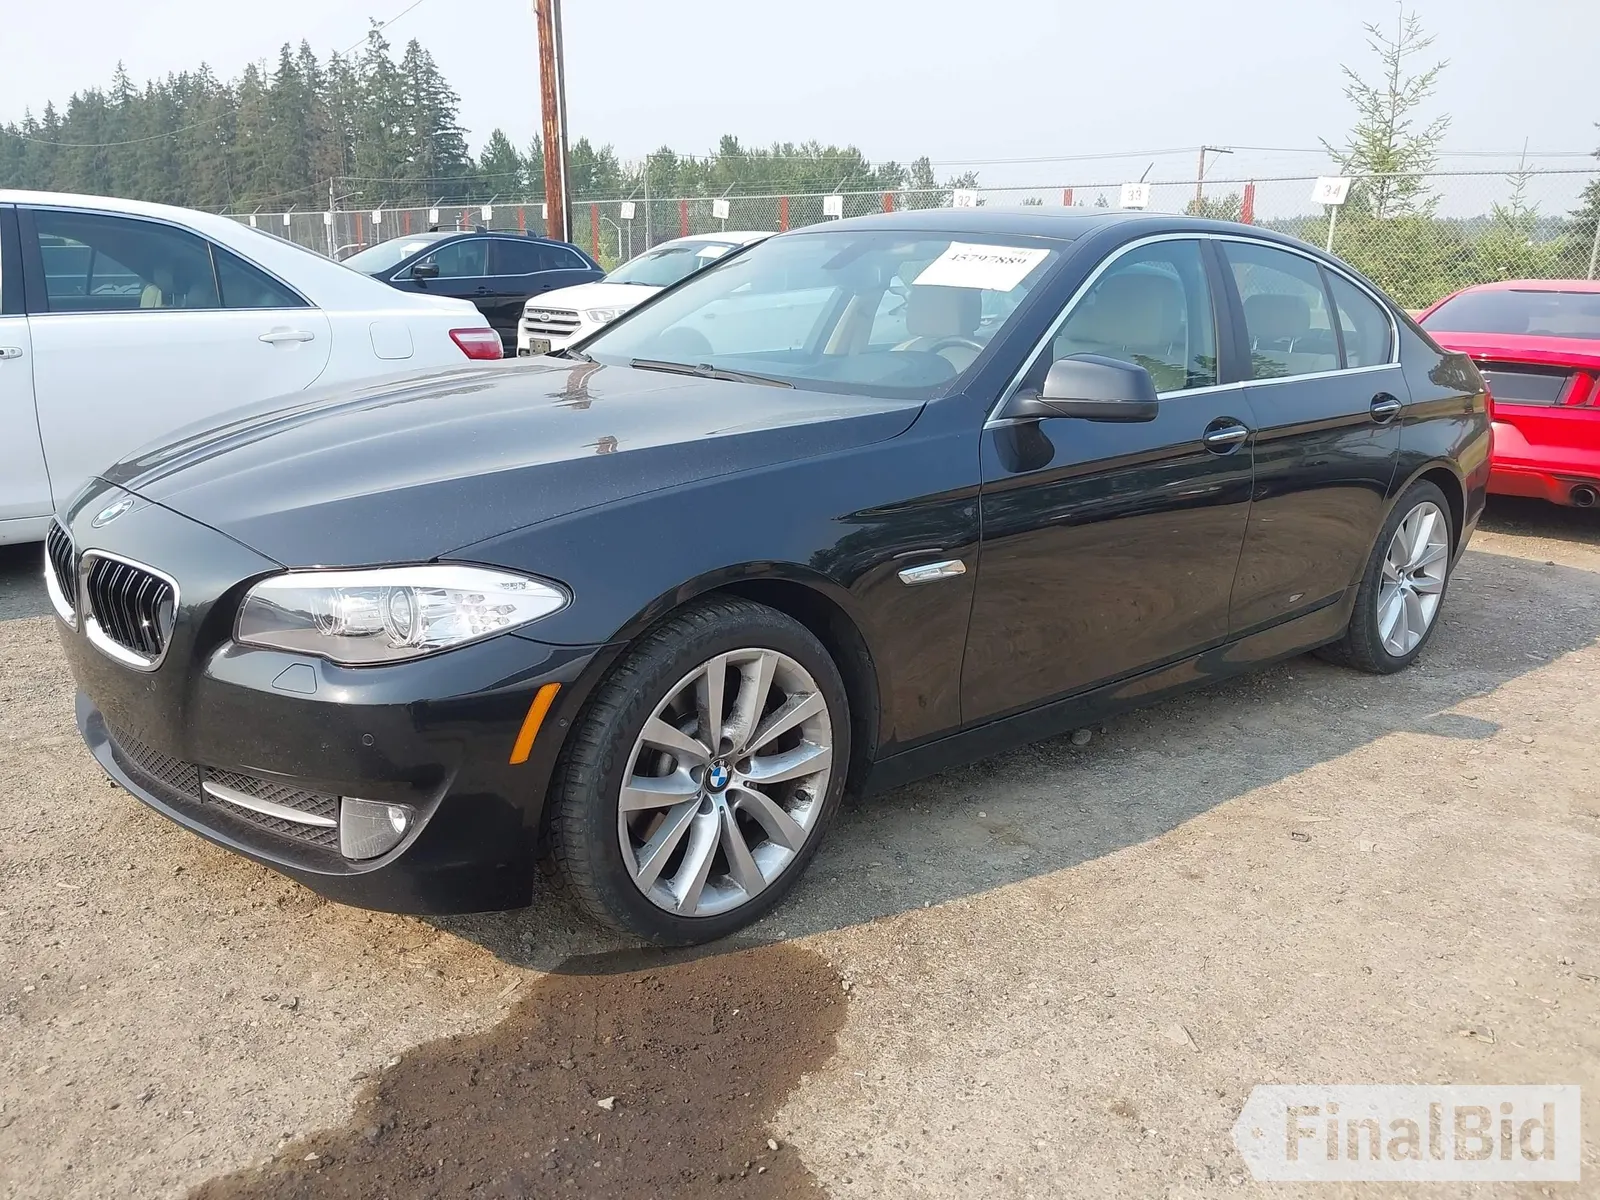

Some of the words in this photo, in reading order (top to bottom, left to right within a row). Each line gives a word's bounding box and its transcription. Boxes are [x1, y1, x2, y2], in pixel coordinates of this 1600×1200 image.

[1127, 189, 1142, 201] 33
[1323, 184, 1342, 198] 34
[958, 195, 971, 207] 32
[709, 760, 733, 772] BMW
